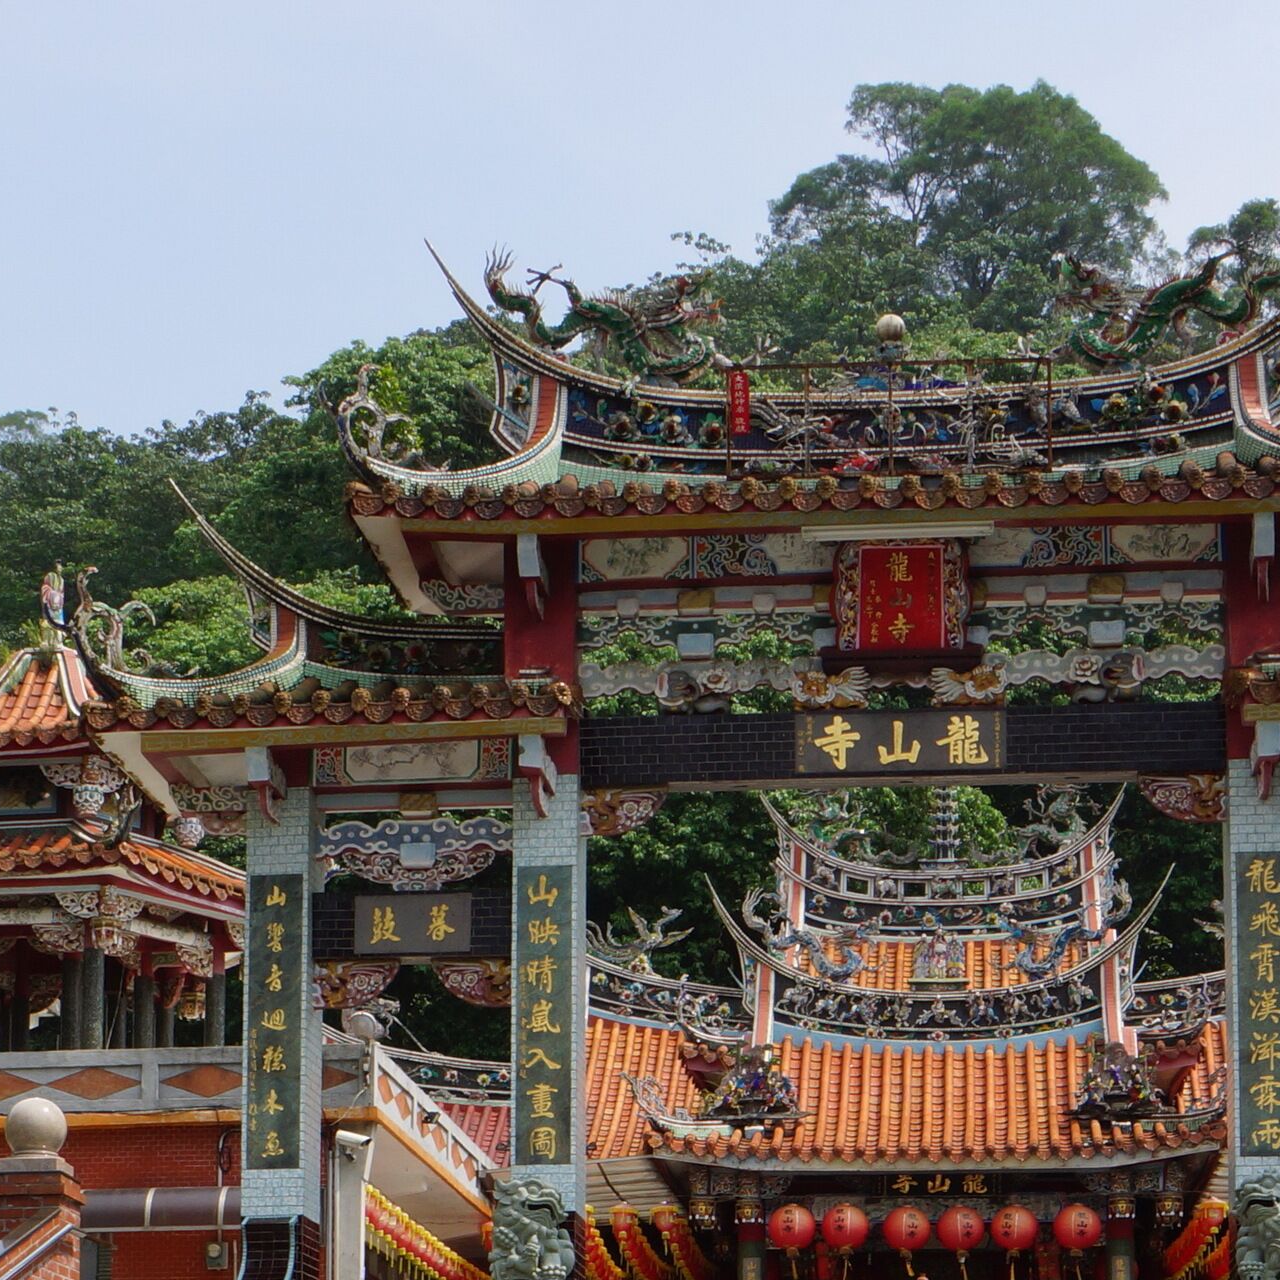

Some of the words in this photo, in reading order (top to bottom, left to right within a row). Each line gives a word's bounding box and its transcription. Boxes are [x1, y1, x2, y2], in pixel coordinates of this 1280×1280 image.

[886, 552, 916, 644] 龍山寺
[813, 714, 990, 771] 龍山寺
[370, 903, 456, 945] 暮鼓
[524, 874, 562, 1160] 山映晴嵐入畫圖
[891, 1174, 988, 1194] 龍山寺
